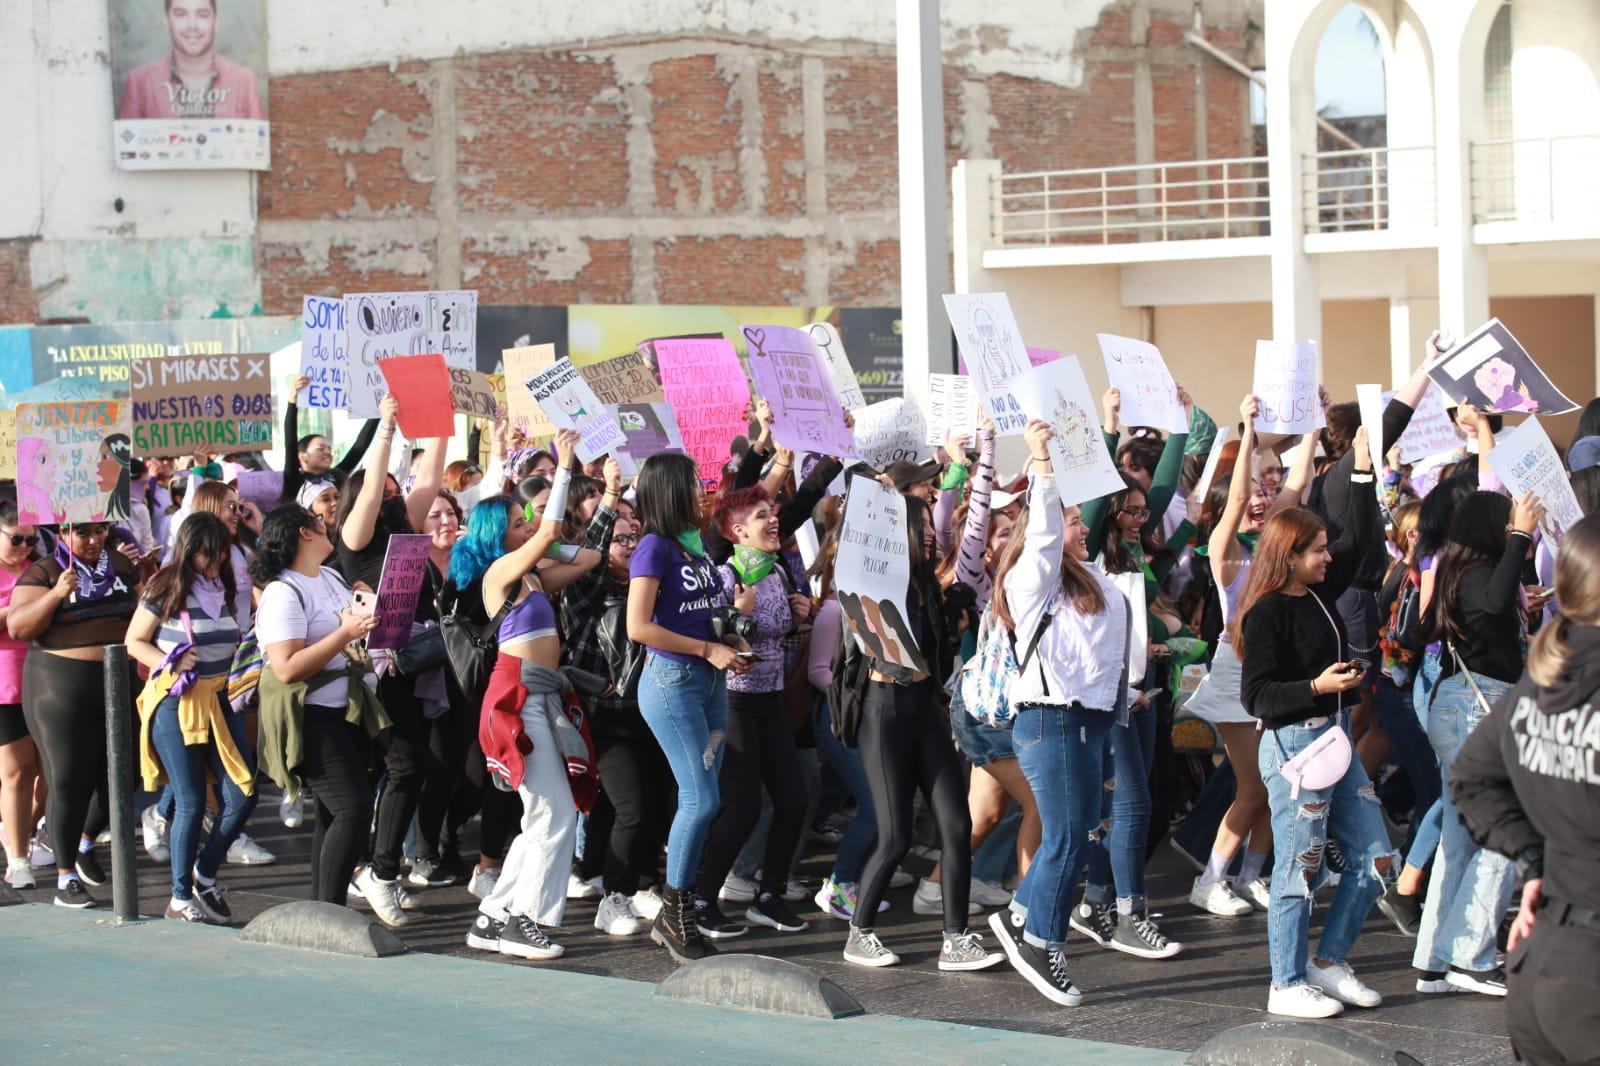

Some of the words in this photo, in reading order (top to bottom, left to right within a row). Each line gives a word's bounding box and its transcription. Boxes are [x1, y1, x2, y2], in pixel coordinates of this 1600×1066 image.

[70, 343, 162, 363] EXCLUSIVIDAD
[183, 341, 222, 356] VIVIR
[99, 366, 129, 382] PISO
[132, 359, 153, 389] SI
[161, 357, 240, 386] MIRASES
[232, 393, 272, 416] OJOS
[134, 420, 237, 450] GRITARIAS
